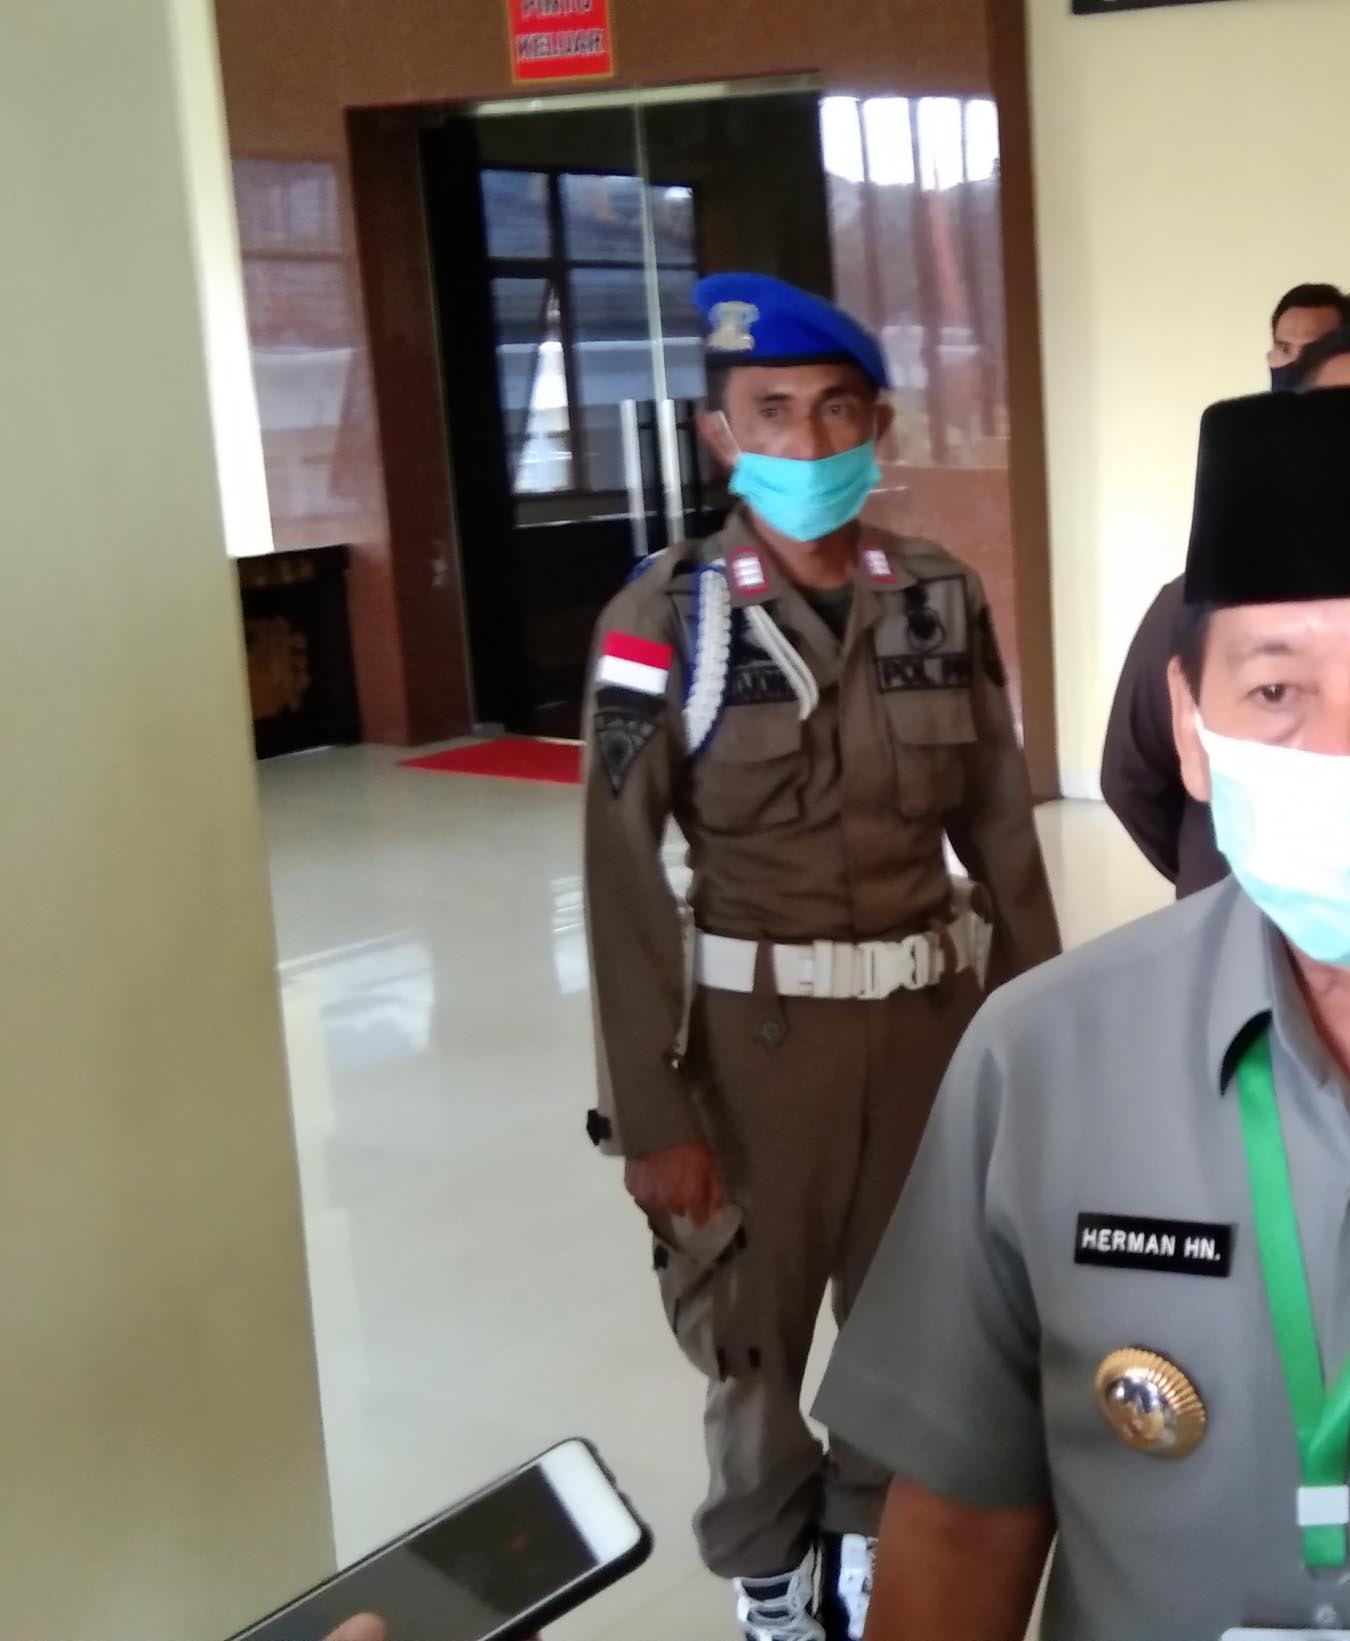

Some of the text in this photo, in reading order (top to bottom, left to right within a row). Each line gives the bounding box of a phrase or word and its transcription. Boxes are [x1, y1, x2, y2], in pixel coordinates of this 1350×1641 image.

[517, 29, 603, 61] KELUAR
[1081, 1227, 1221, 1261] HERMAN HN.
